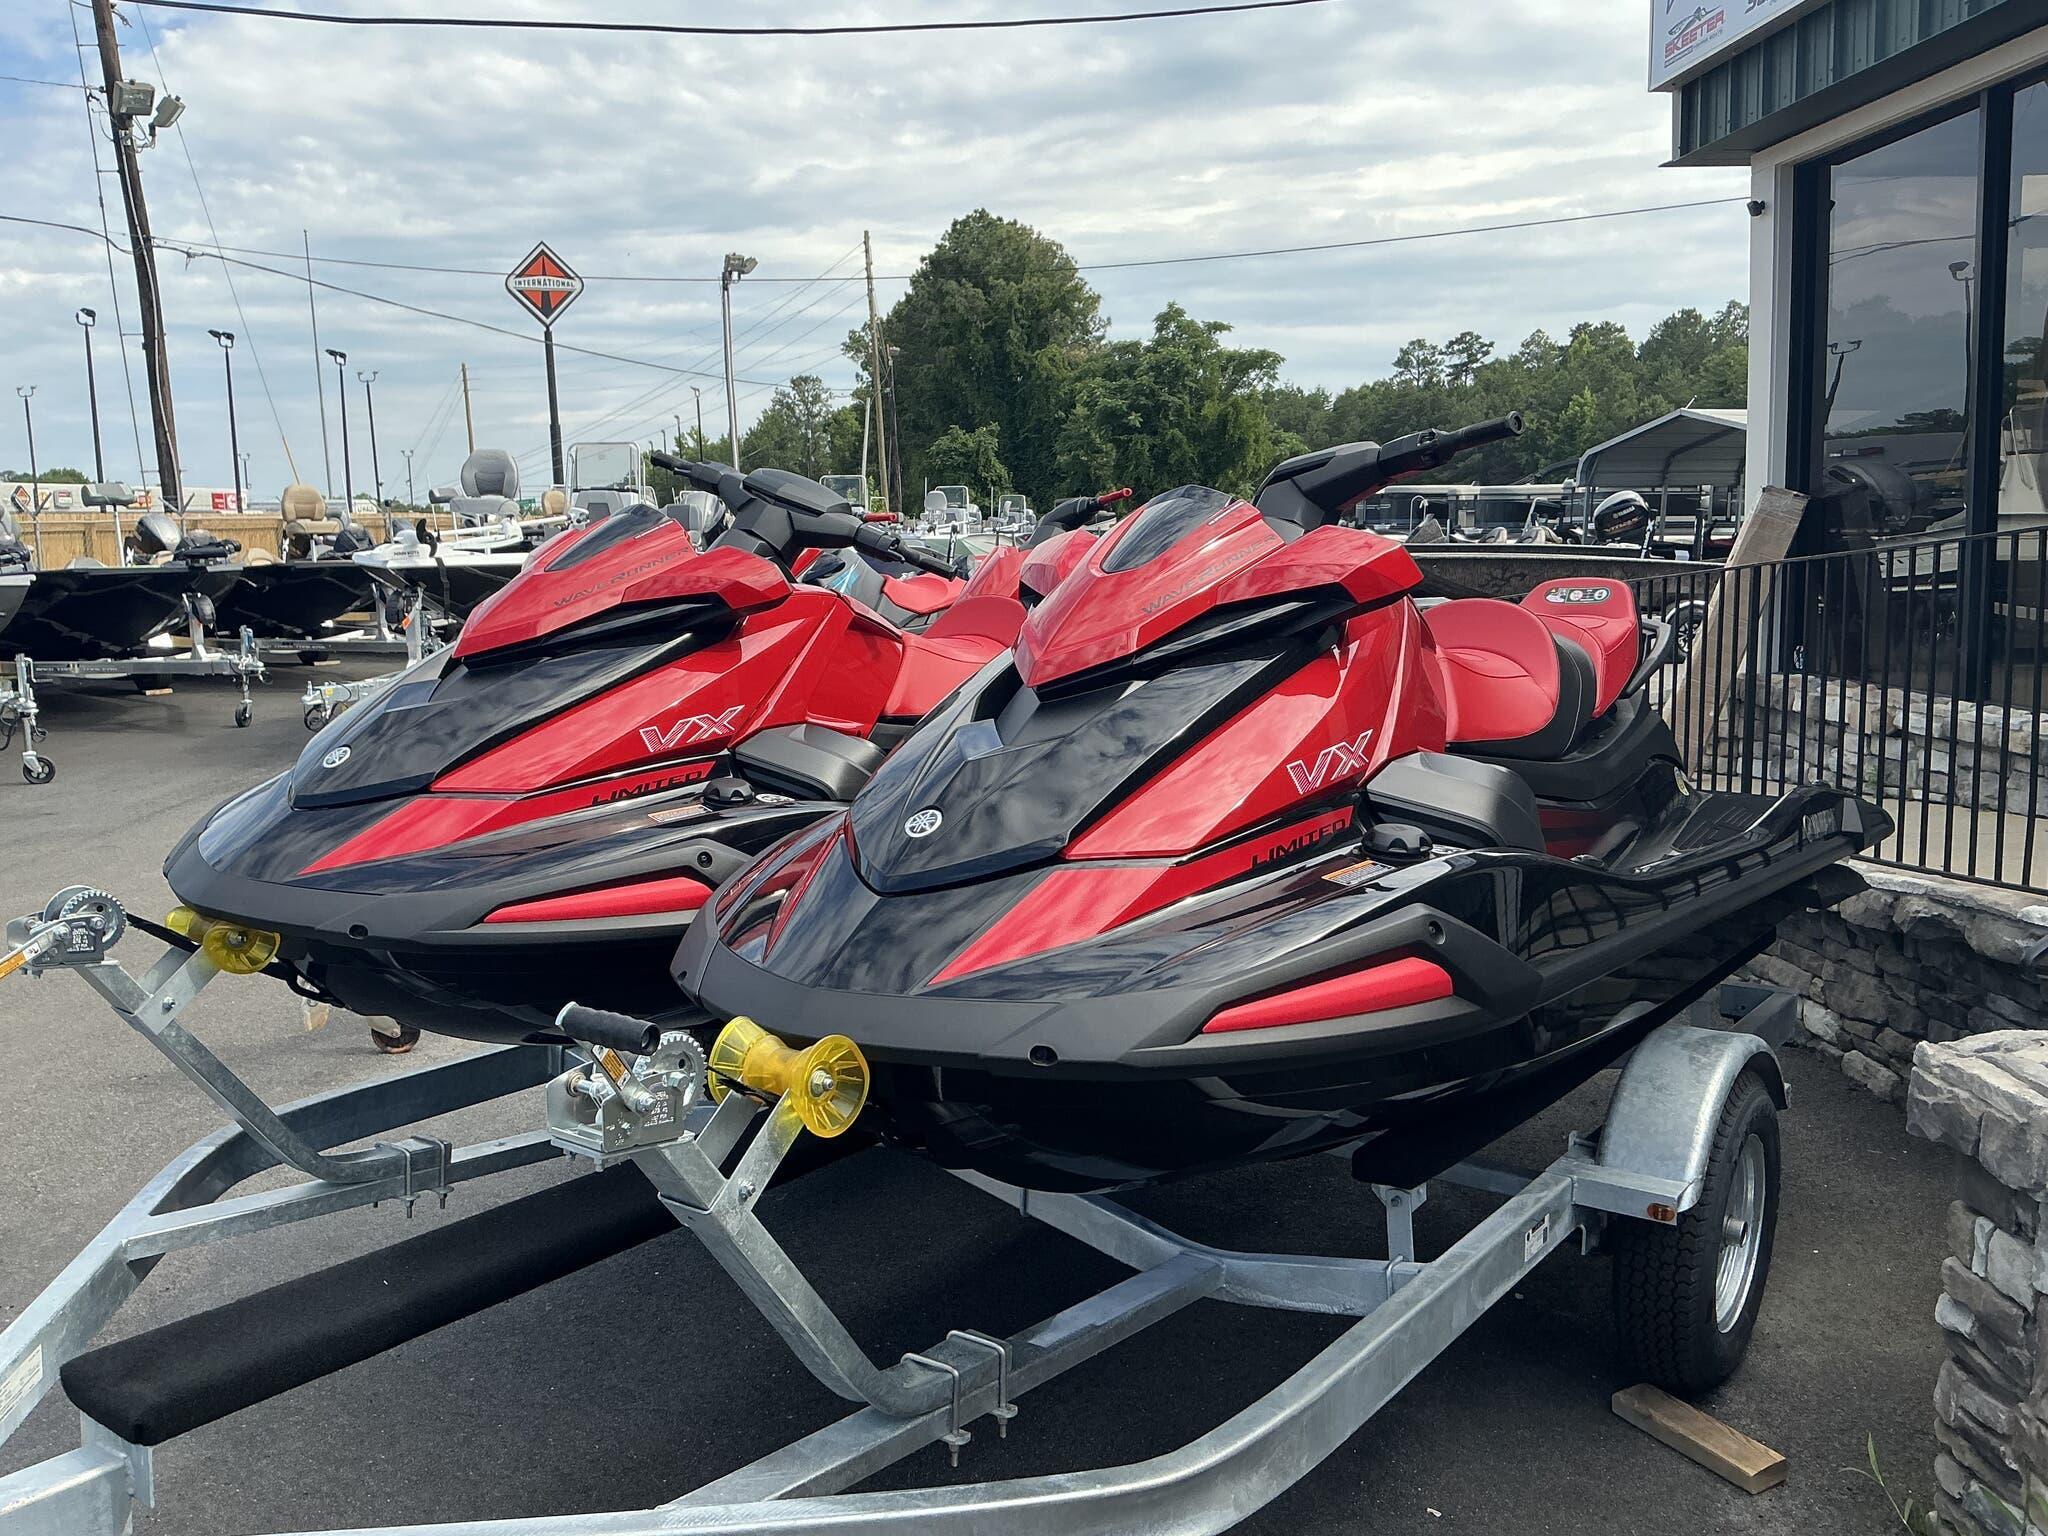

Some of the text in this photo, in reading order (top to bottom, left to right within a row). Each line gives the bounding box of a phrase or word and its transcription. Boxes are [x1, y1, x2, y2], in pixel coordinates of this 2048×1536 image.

[1665, 10, 1725, 59] SKEETER
[514, 278, 575, 288] INTERNATIONAL
[553, 547, 690, 607] WAVERUNNER
[639, 704, 745, 752] VX
[1286, 729, 1373, 795] VX
[592, 771, 704, 806] LIMITED
[1251, 818, 1346, 869] LIMITED
